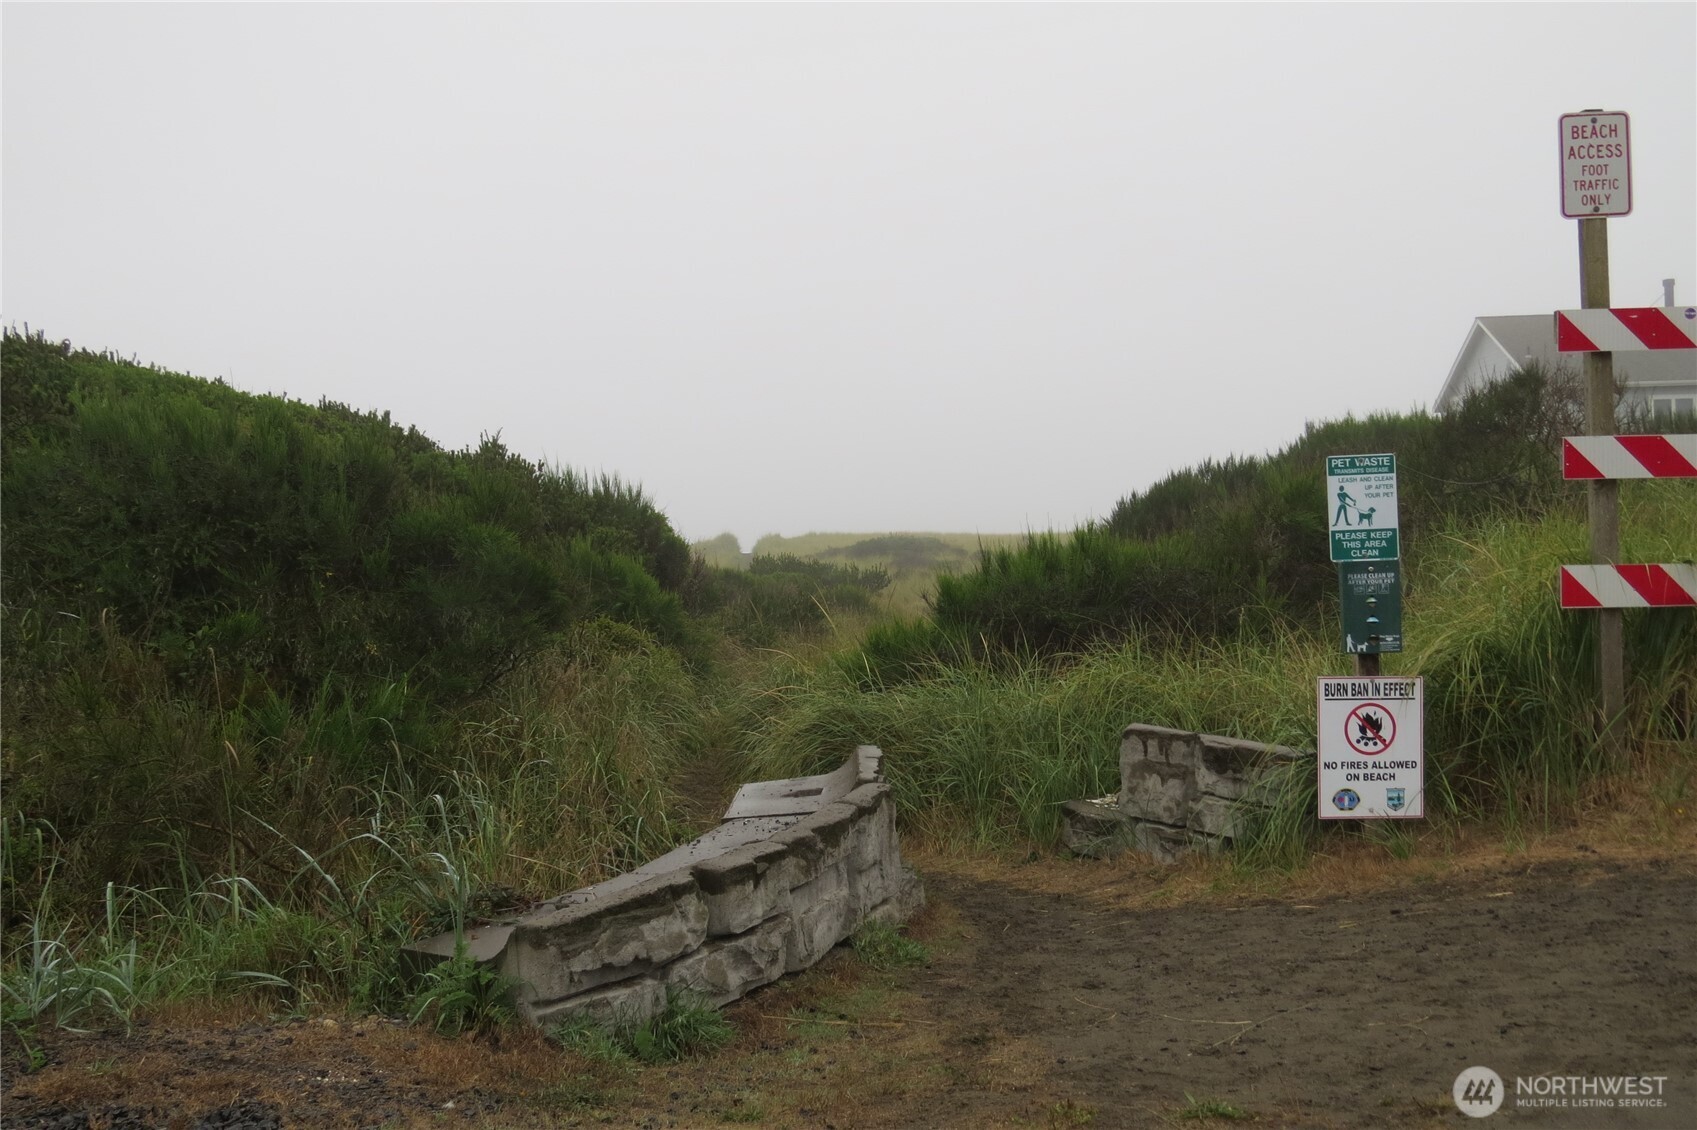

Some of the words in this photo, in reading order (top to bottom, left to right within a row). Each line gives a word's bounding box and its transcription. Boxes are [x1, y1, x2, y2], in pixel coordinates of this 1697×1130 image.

[1571, 124, 1618, 140] BEACH
[1568, 144, 1622, 160] ACCESS
[1582, 164, 1609, 176] FOOT
[1573, 178, 1619, 191] TRAFFIC
[1581, 194, 1611, 206] ONLY
[1332, 458, 1350, 468] PET
[1354, 457, 1390, 466] WASTE
[1336, 532, 1367, 540] PLEASE
[1364, 540, 1387, 548] AREA
[1324, 682, 1348, 697] BURN
[1351, 682, 1369, 696] BAN
[1372, 682, 1380, 696] IN
[1383, 682, 1416, 696] EFFECT
[1324, 762, 1338, 770] NO
[1341, 762, 1368, 770] FIRES
[1372, 760, 1418, 769] ALLOWED
[1346, 773, 1360, 782] ON
[1363, 772, 1396, 781] BEACH
